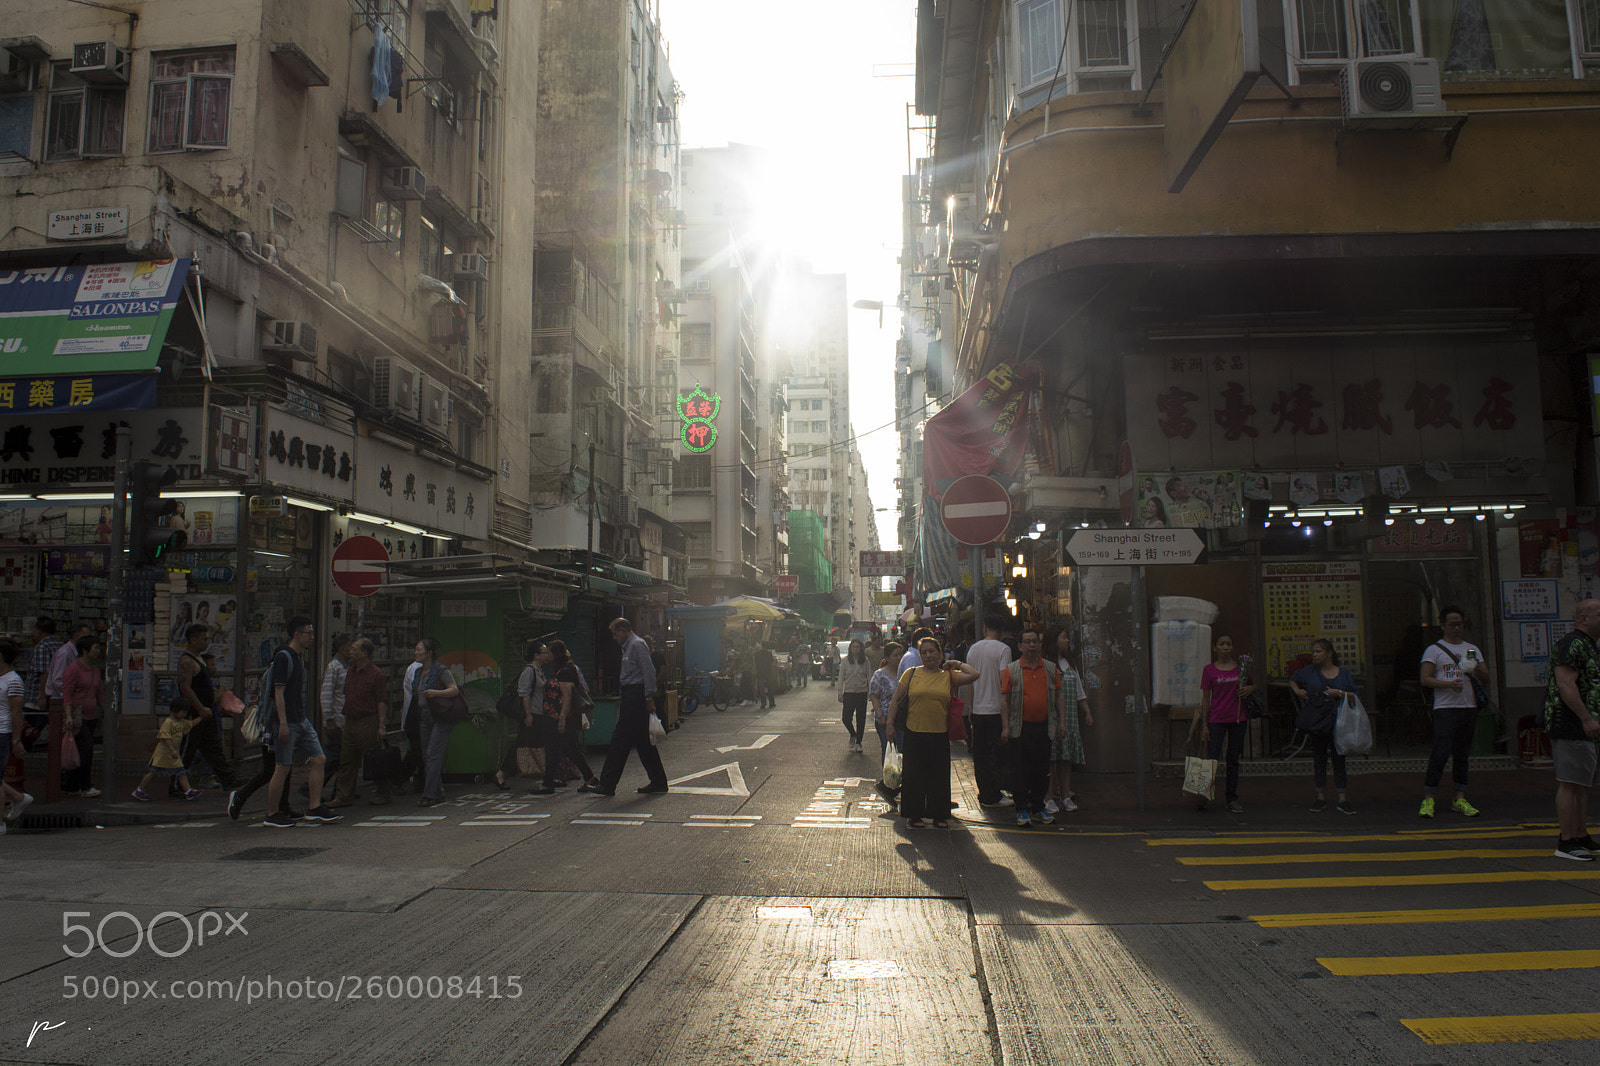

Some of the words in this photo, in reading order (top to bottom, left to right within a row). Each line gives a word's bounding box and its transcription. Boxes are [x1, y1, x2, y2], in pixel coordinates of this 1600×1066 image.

[55, 212, 91, 223] Shanghai
[95, 211, 121, 219] Street
[69, 222, 104, 236] 上海街
[70, 300, 160, 317] SALONPAS
[687, 423, 710, 446] 押
[1, 468, 41, 483] HING
[1094, 533, 1141, 544] Shanghai
[1143, 533, 1176, 543] Street
[1113, 549, 1157, 561] 上海街
